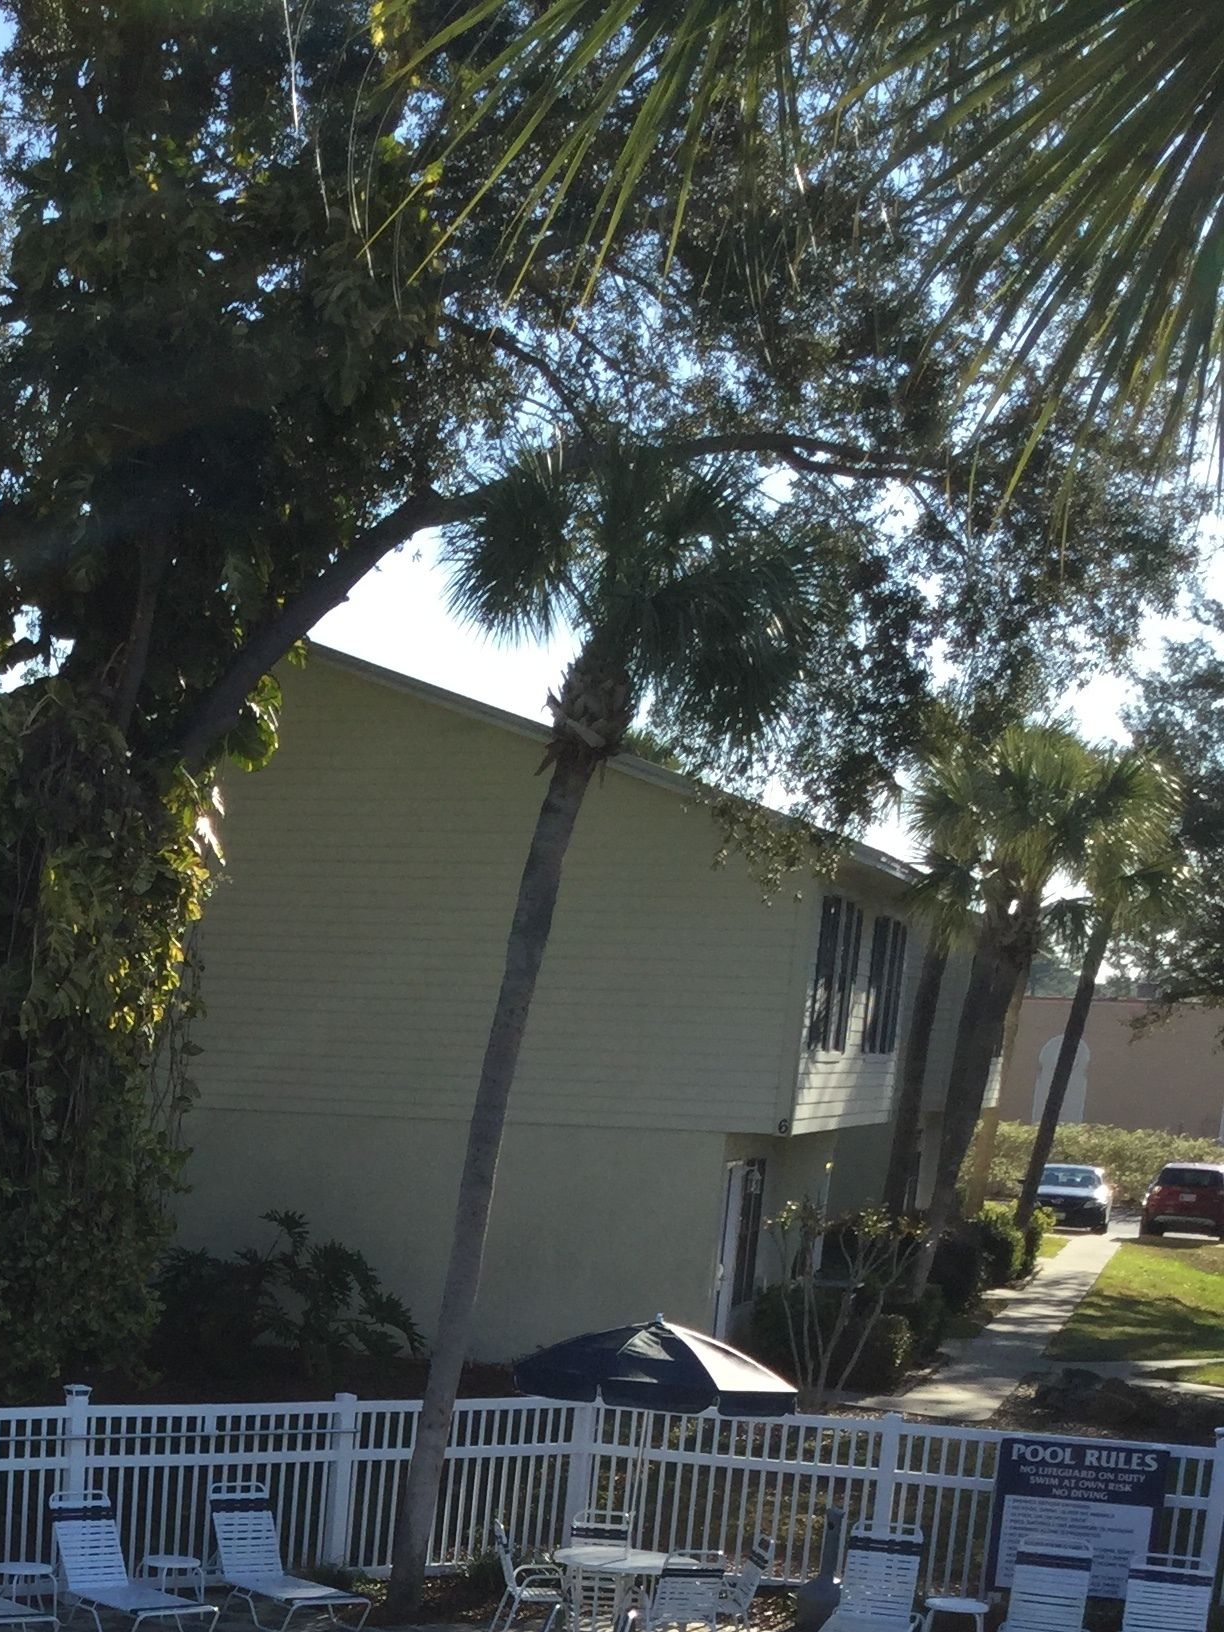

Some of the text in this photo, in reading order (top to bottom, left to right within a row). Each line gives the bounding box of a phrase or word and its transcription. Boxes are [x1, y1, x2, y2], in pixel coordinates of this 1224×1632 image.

[778, 1118, 788, 1134] 6
[1011, 1443, 1159, 1472] POOL RULES
[1019, 1465, 1146, 1483] NO LIFEGUARD ON DUTY
[1029, 1475, 1133, 1492] SWIM AT OWN RISK
[1051, 1487, 1109, 1500] NO DIVING
